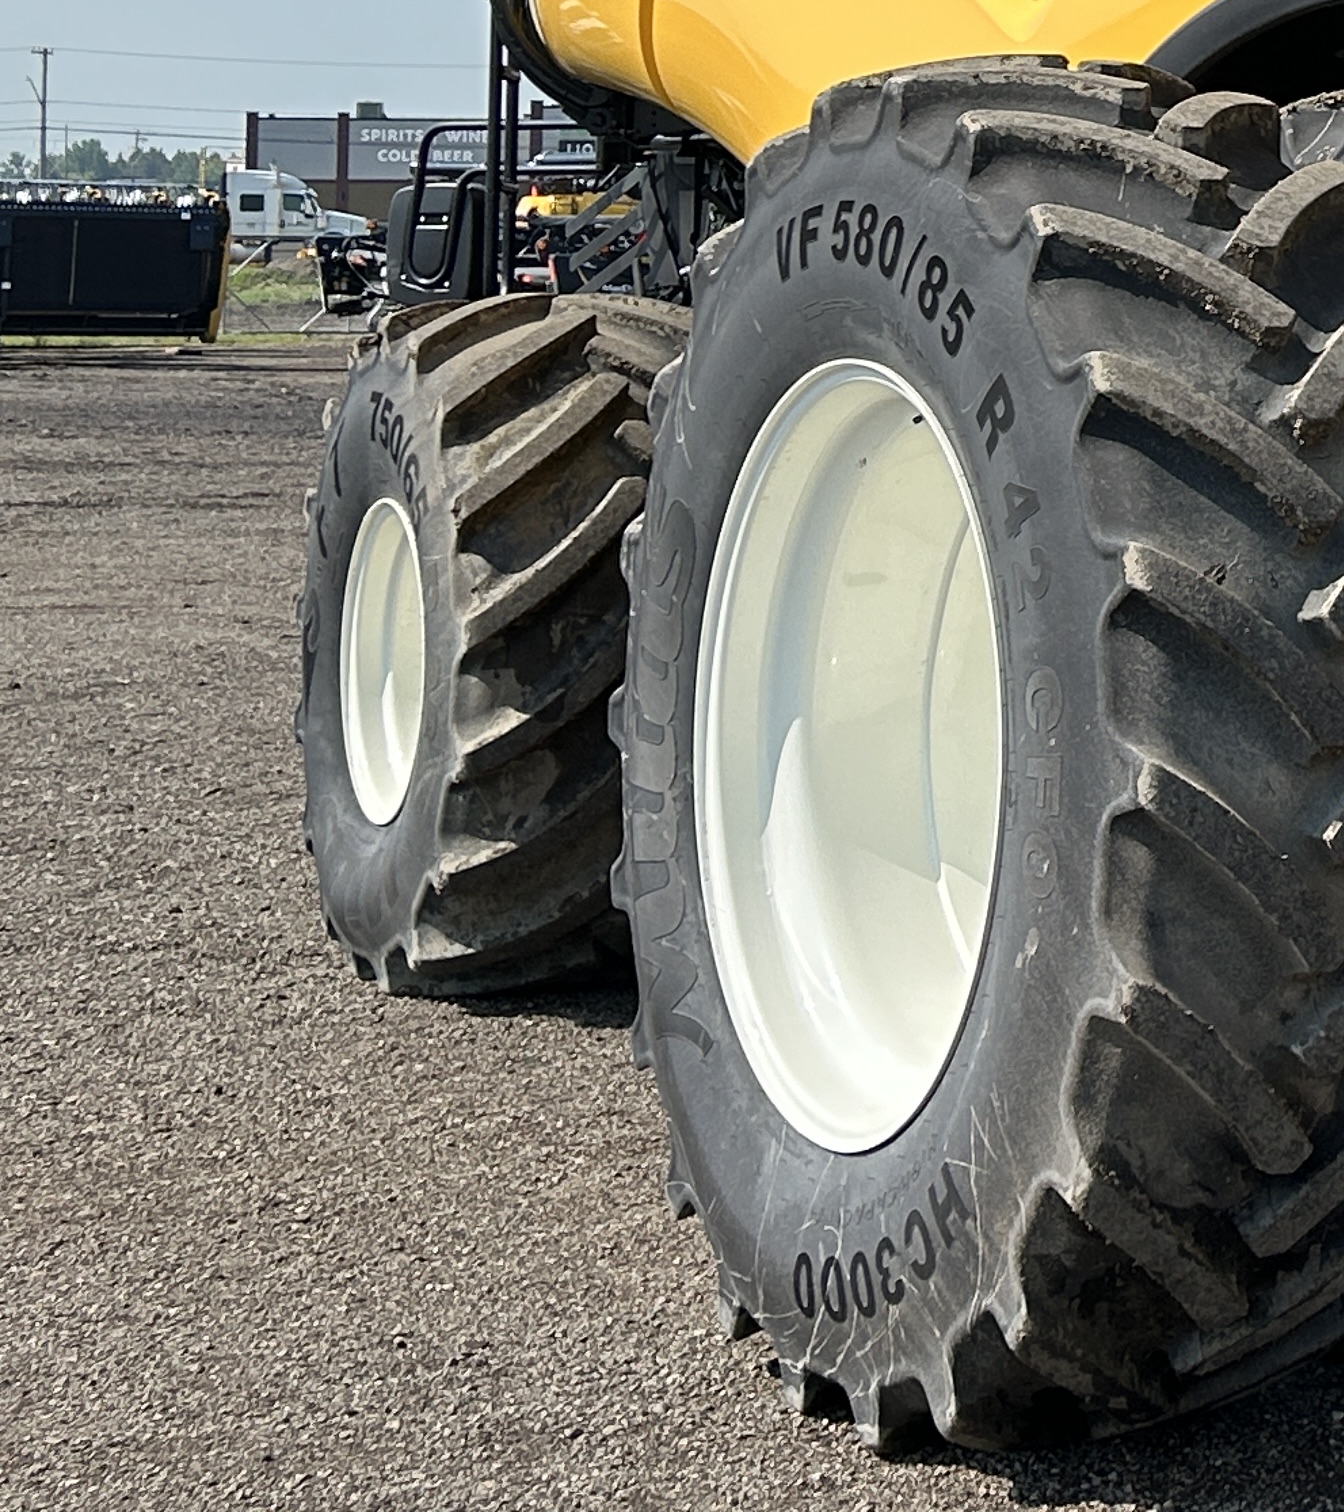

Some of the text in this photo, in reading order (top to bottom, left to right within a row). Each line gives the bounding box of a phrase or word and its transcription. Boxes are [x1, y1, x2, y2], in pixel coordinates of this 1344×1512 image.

[360, 129, 424, 143] SPIRITS
[433, 150, 474, 162] BEER
[776, 204, 823, 282] VF
[831, 200, 975, 356] 580/85
[976, 373, 1016, 460] R
[793, 1160, 974, 1324] HC3000
